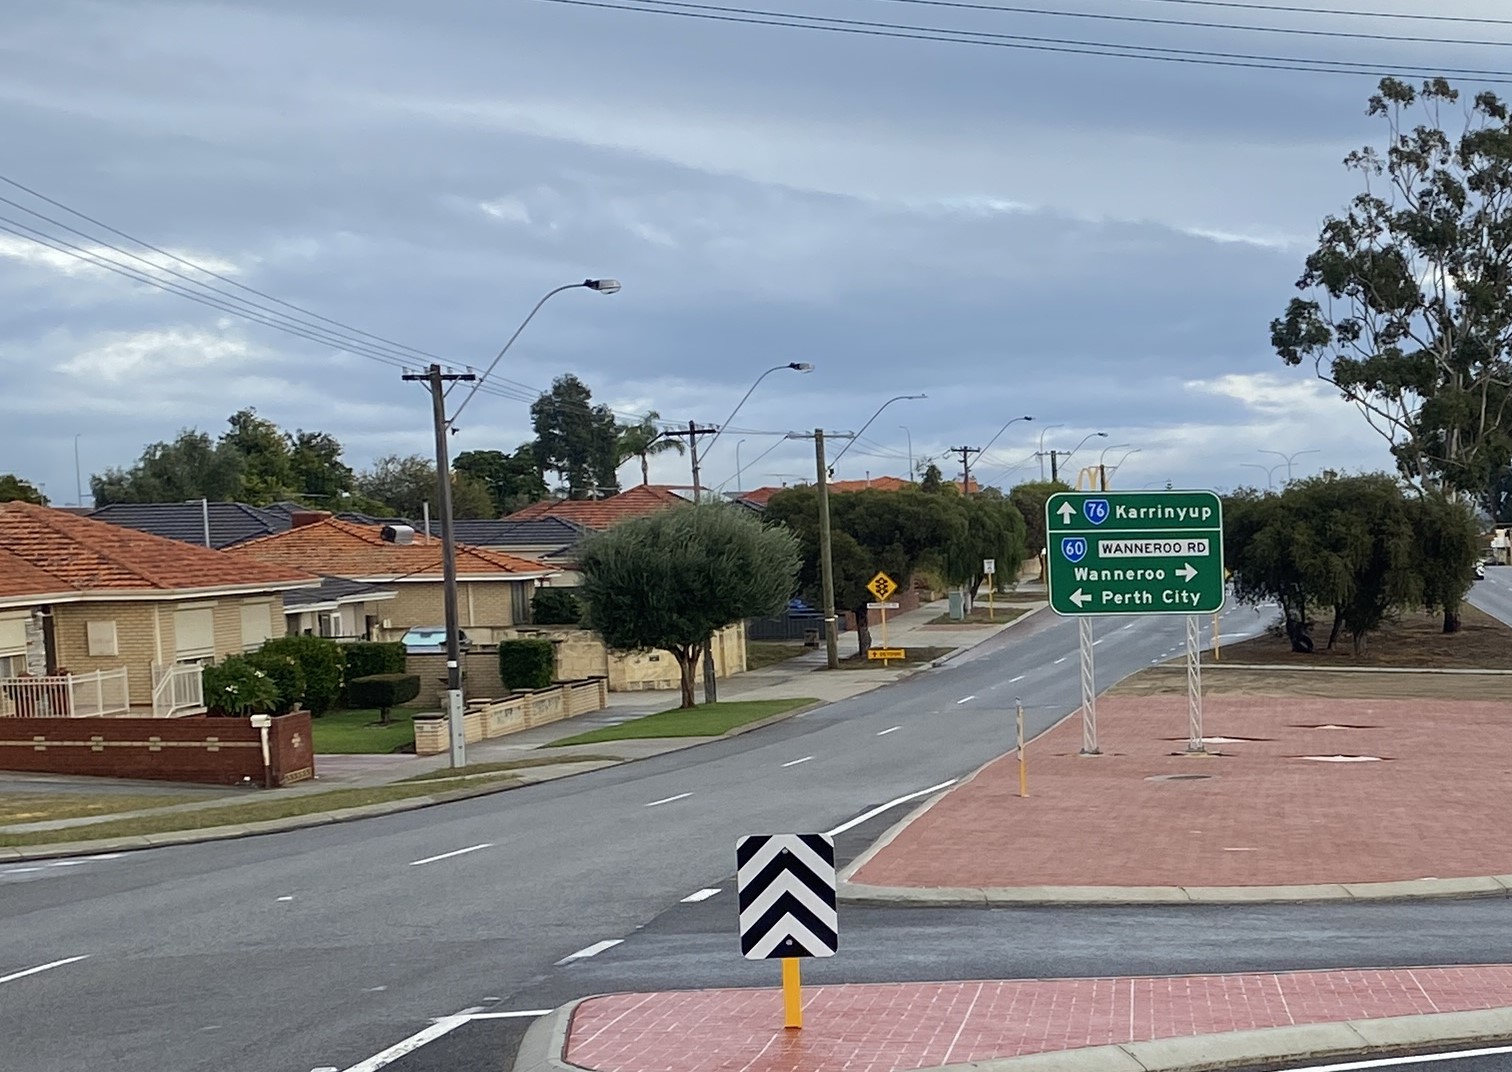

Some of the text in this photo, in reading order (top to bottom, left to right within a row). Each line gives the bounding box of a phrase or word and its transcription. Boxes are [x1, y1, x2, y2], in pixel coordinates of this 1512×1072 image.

[1088, 503, 1105, 518] 76
[1115, 504, 1212, 521] Karrinyup
[1065, 541, 1083, 556] 60
[1102, 541, 1206, 554] WANNEROO RD
[1074, 567, 1166, 581] Wanneroo
[1102, 590, 1201, 606] Perth City
